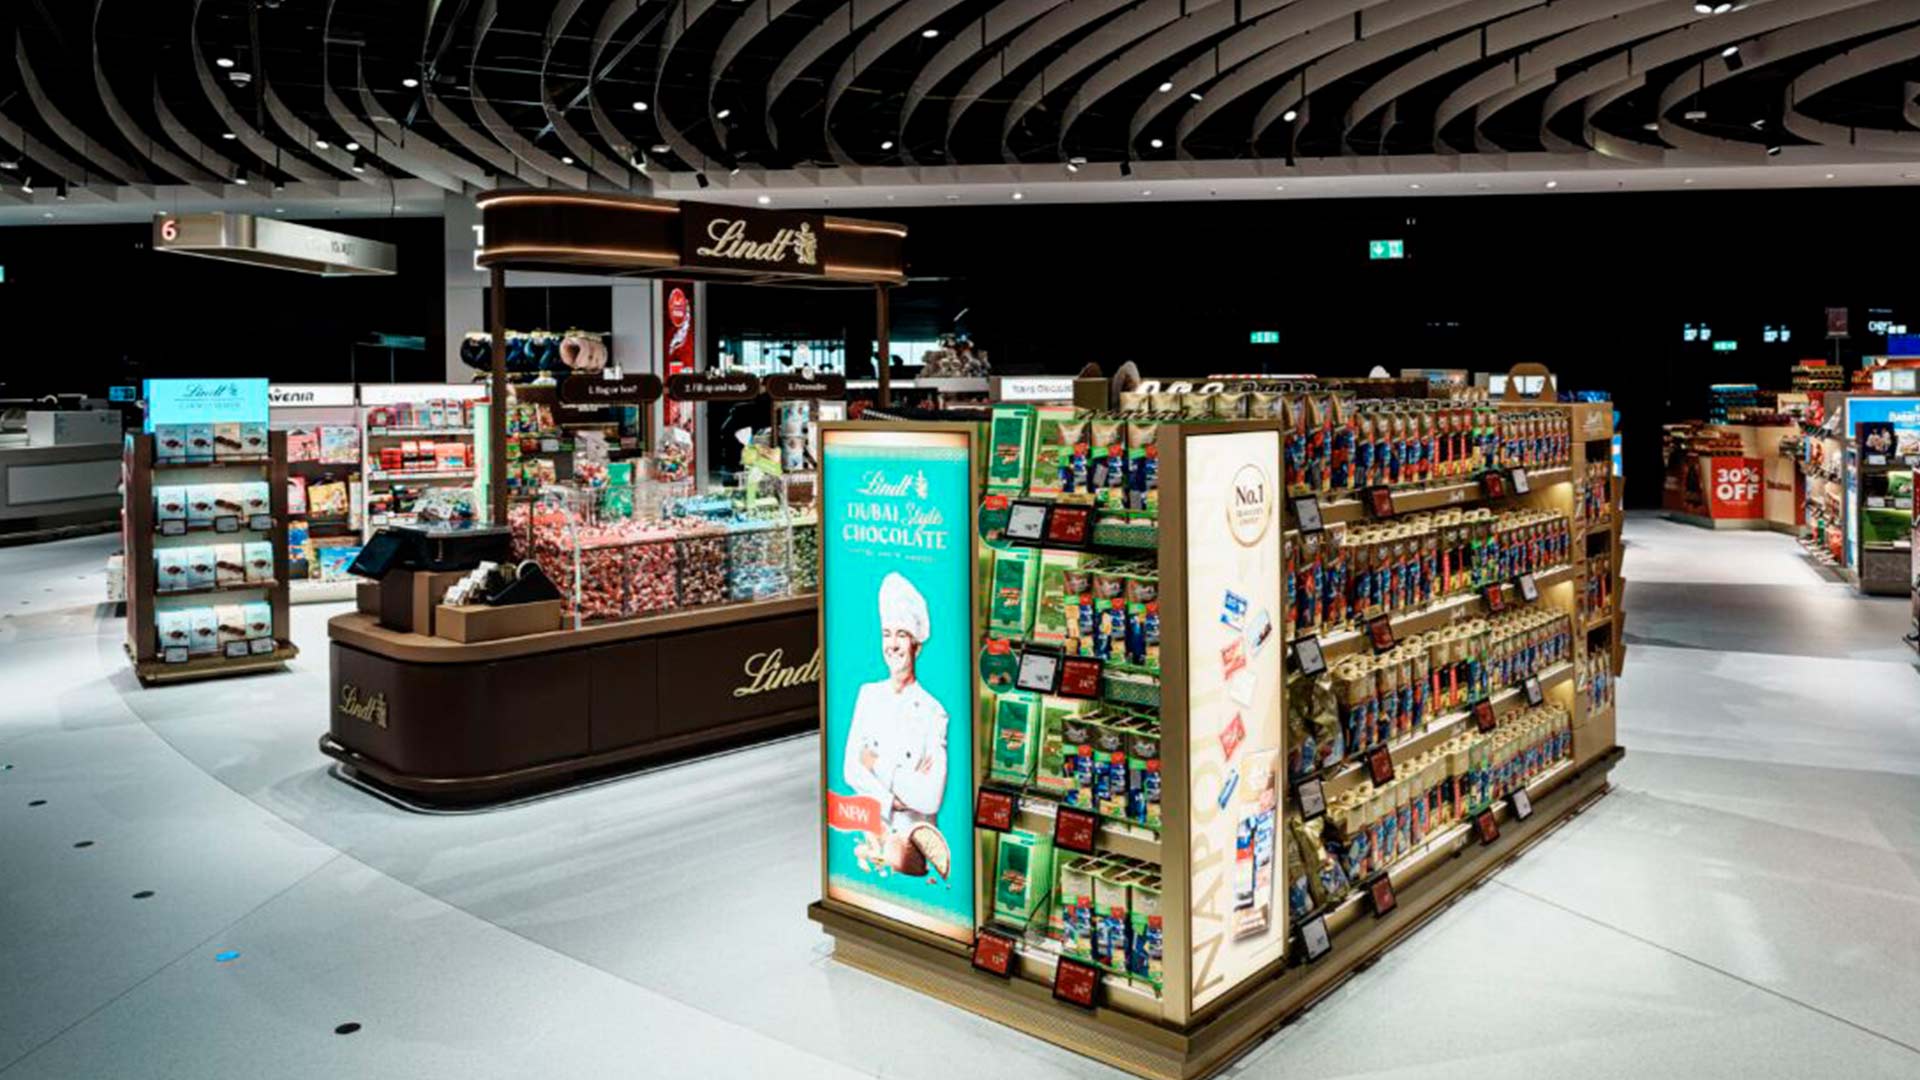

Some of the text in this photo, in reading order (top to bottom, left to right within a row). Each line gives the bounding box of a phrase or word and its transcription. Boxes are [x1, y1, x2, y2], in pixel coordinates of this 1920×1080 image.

[161, 219, 177, 240] 6
[696, 218, 794, 262] Lindt
[856, 470, 914, 497] Lindt
[1717, 468, 1759, 483] 30%
[1236, 484, 1264, 506] No.1
[1716, 484, 1759, 501] OFF
[847, 503, 899, 523] DUBAI
[842, 523, 949, 550] CHOCOLATE
[336, 684, 376, 722] Lindt
[838, 802, 869, 824] NEW
